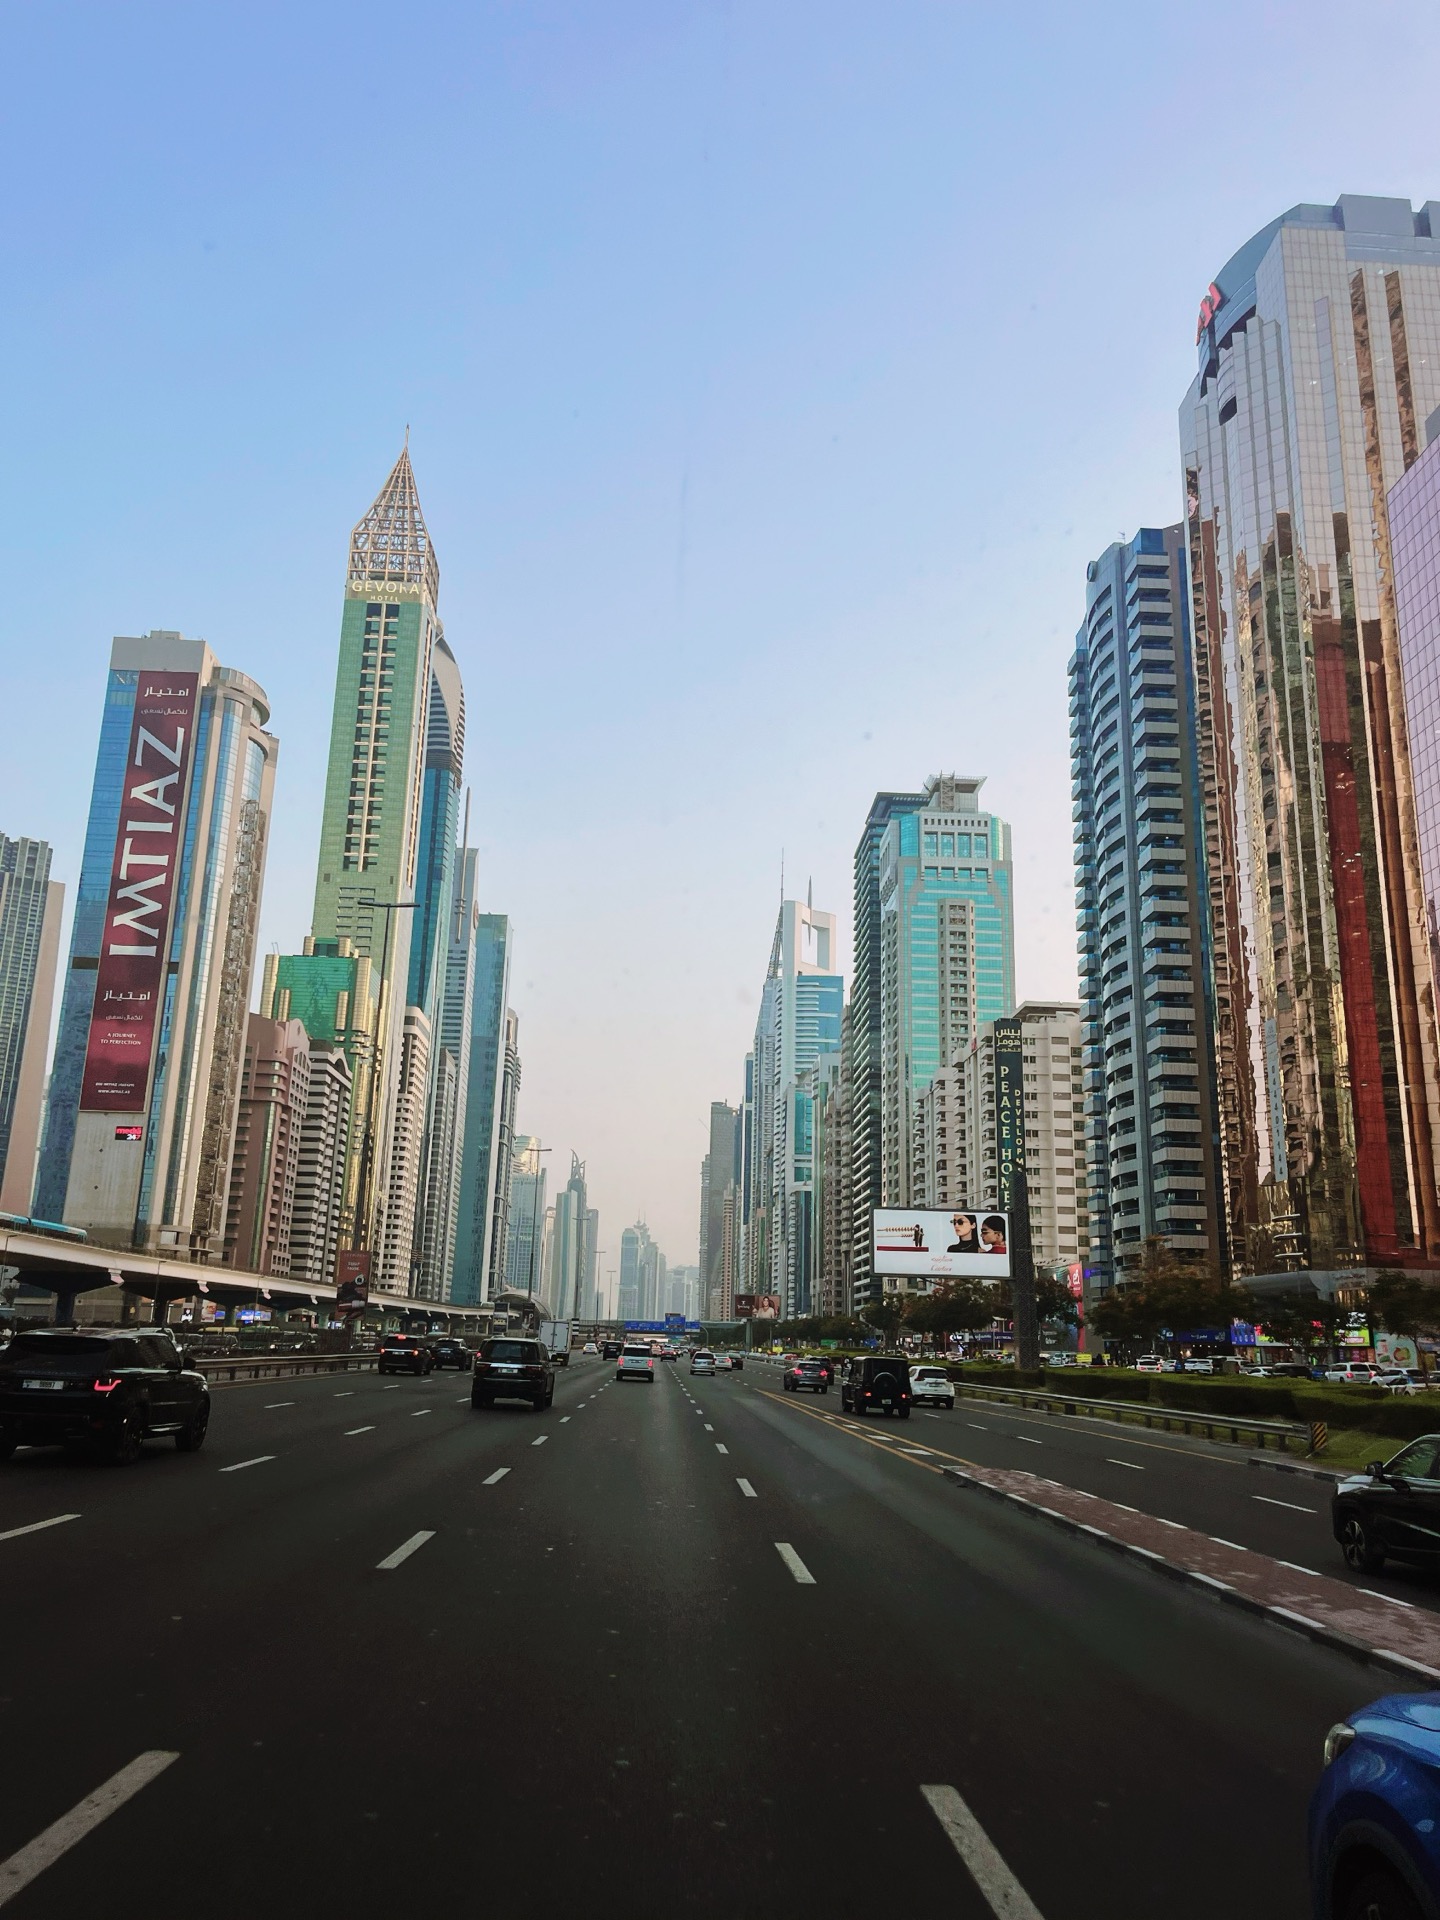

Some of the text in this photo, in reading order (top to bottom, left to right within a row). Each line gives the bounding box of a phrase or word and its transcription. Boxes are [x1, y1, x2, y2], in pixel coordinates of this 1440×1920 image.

[352, 581, 420, 594] GEVORA
[144, 686, 189, 697] امتياز
[108, 725, 185, 957] IMTIAZ
[103, 989, 151, 1001] امتياز
[1000, 1065, 1011, 1139] PEACE
